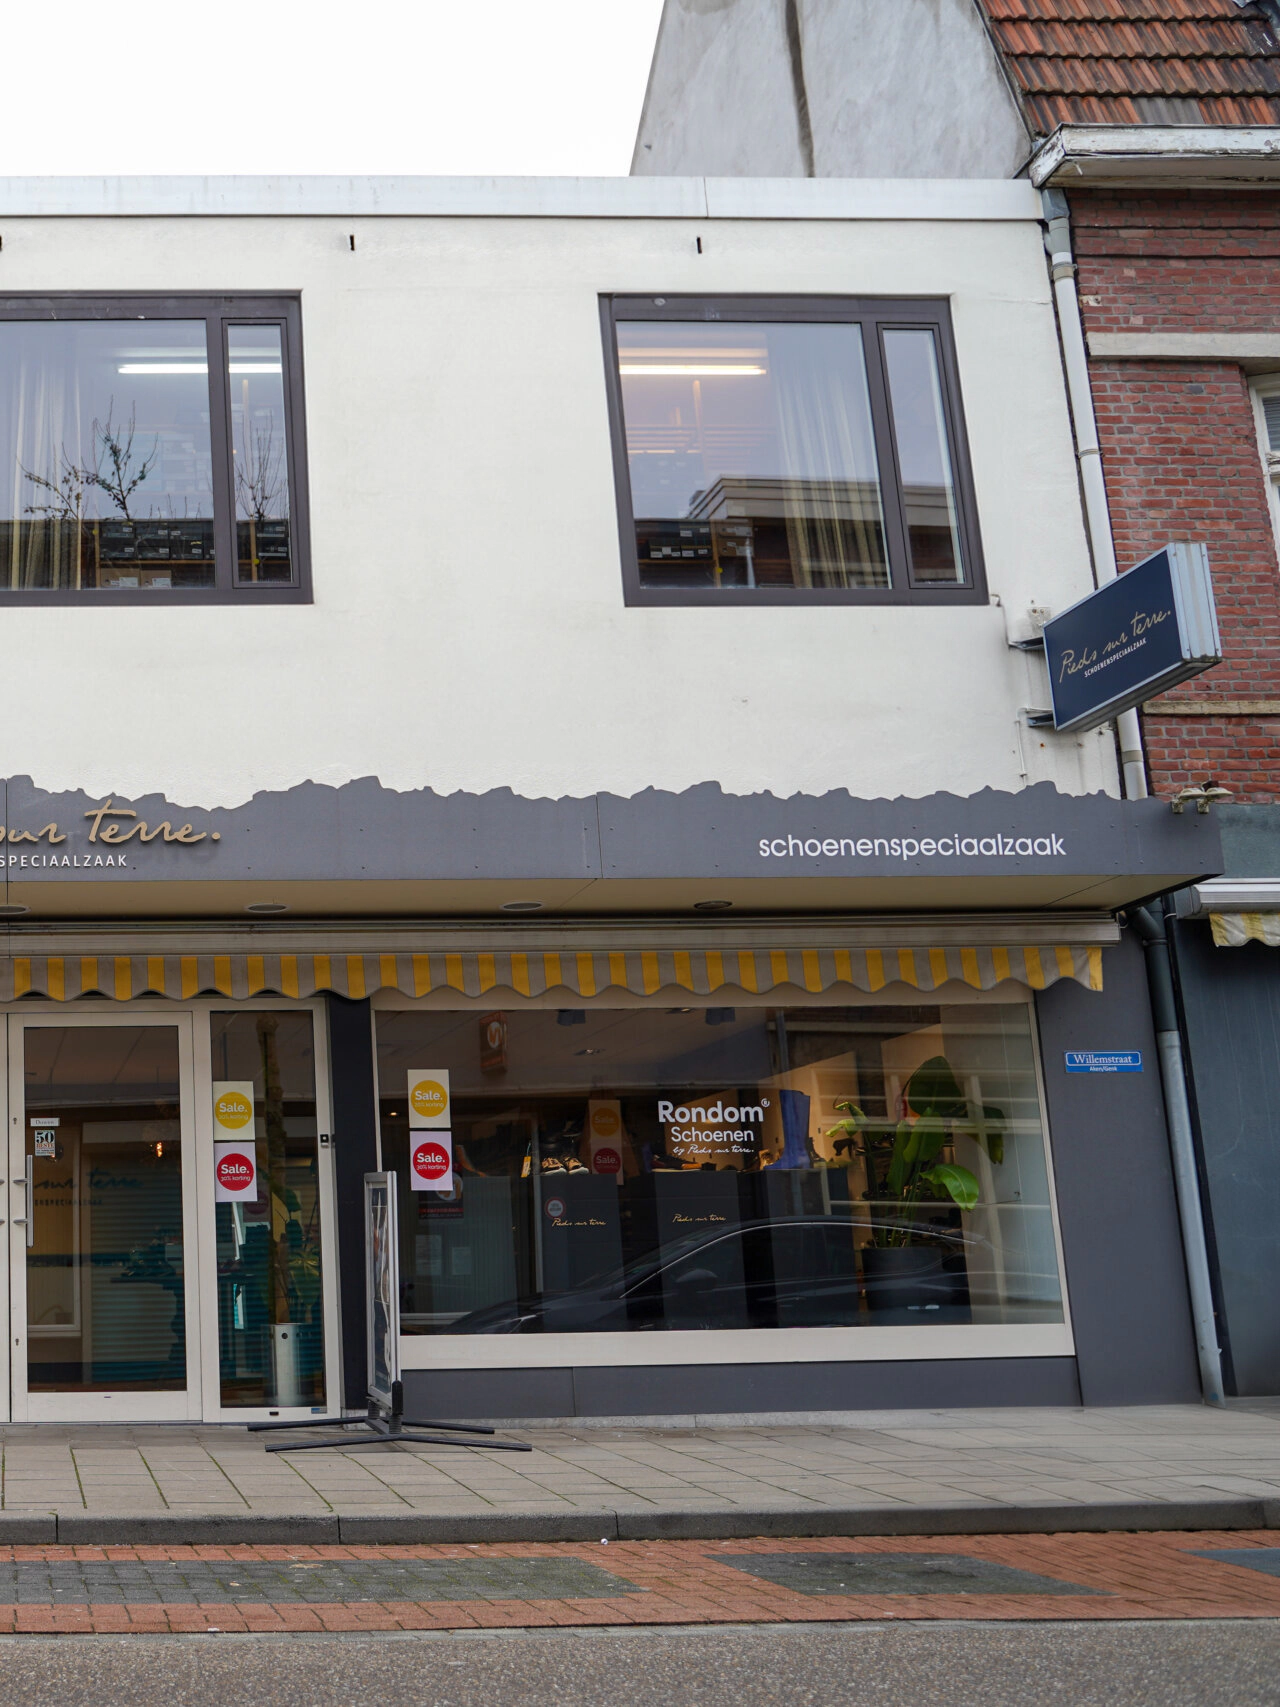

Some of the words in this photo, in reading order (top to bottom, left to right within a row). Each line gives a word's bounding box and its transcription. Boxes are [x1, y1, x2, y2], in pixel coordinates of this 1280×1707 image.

[1058, 649, 1097, 684] Pieds
[1102, 632, 1128, 655] sur
[1083, 637, 1147, 678] SCHOENENSPECIAALZAAK
[758, 833, 1067, 860] schoenenspeciaalzaak
[1073, 1054, 1133, 1064] Willemstraat
[36, 1131, 54, 1143] 50
[670, 1126, 755, 1142] Schoenen
